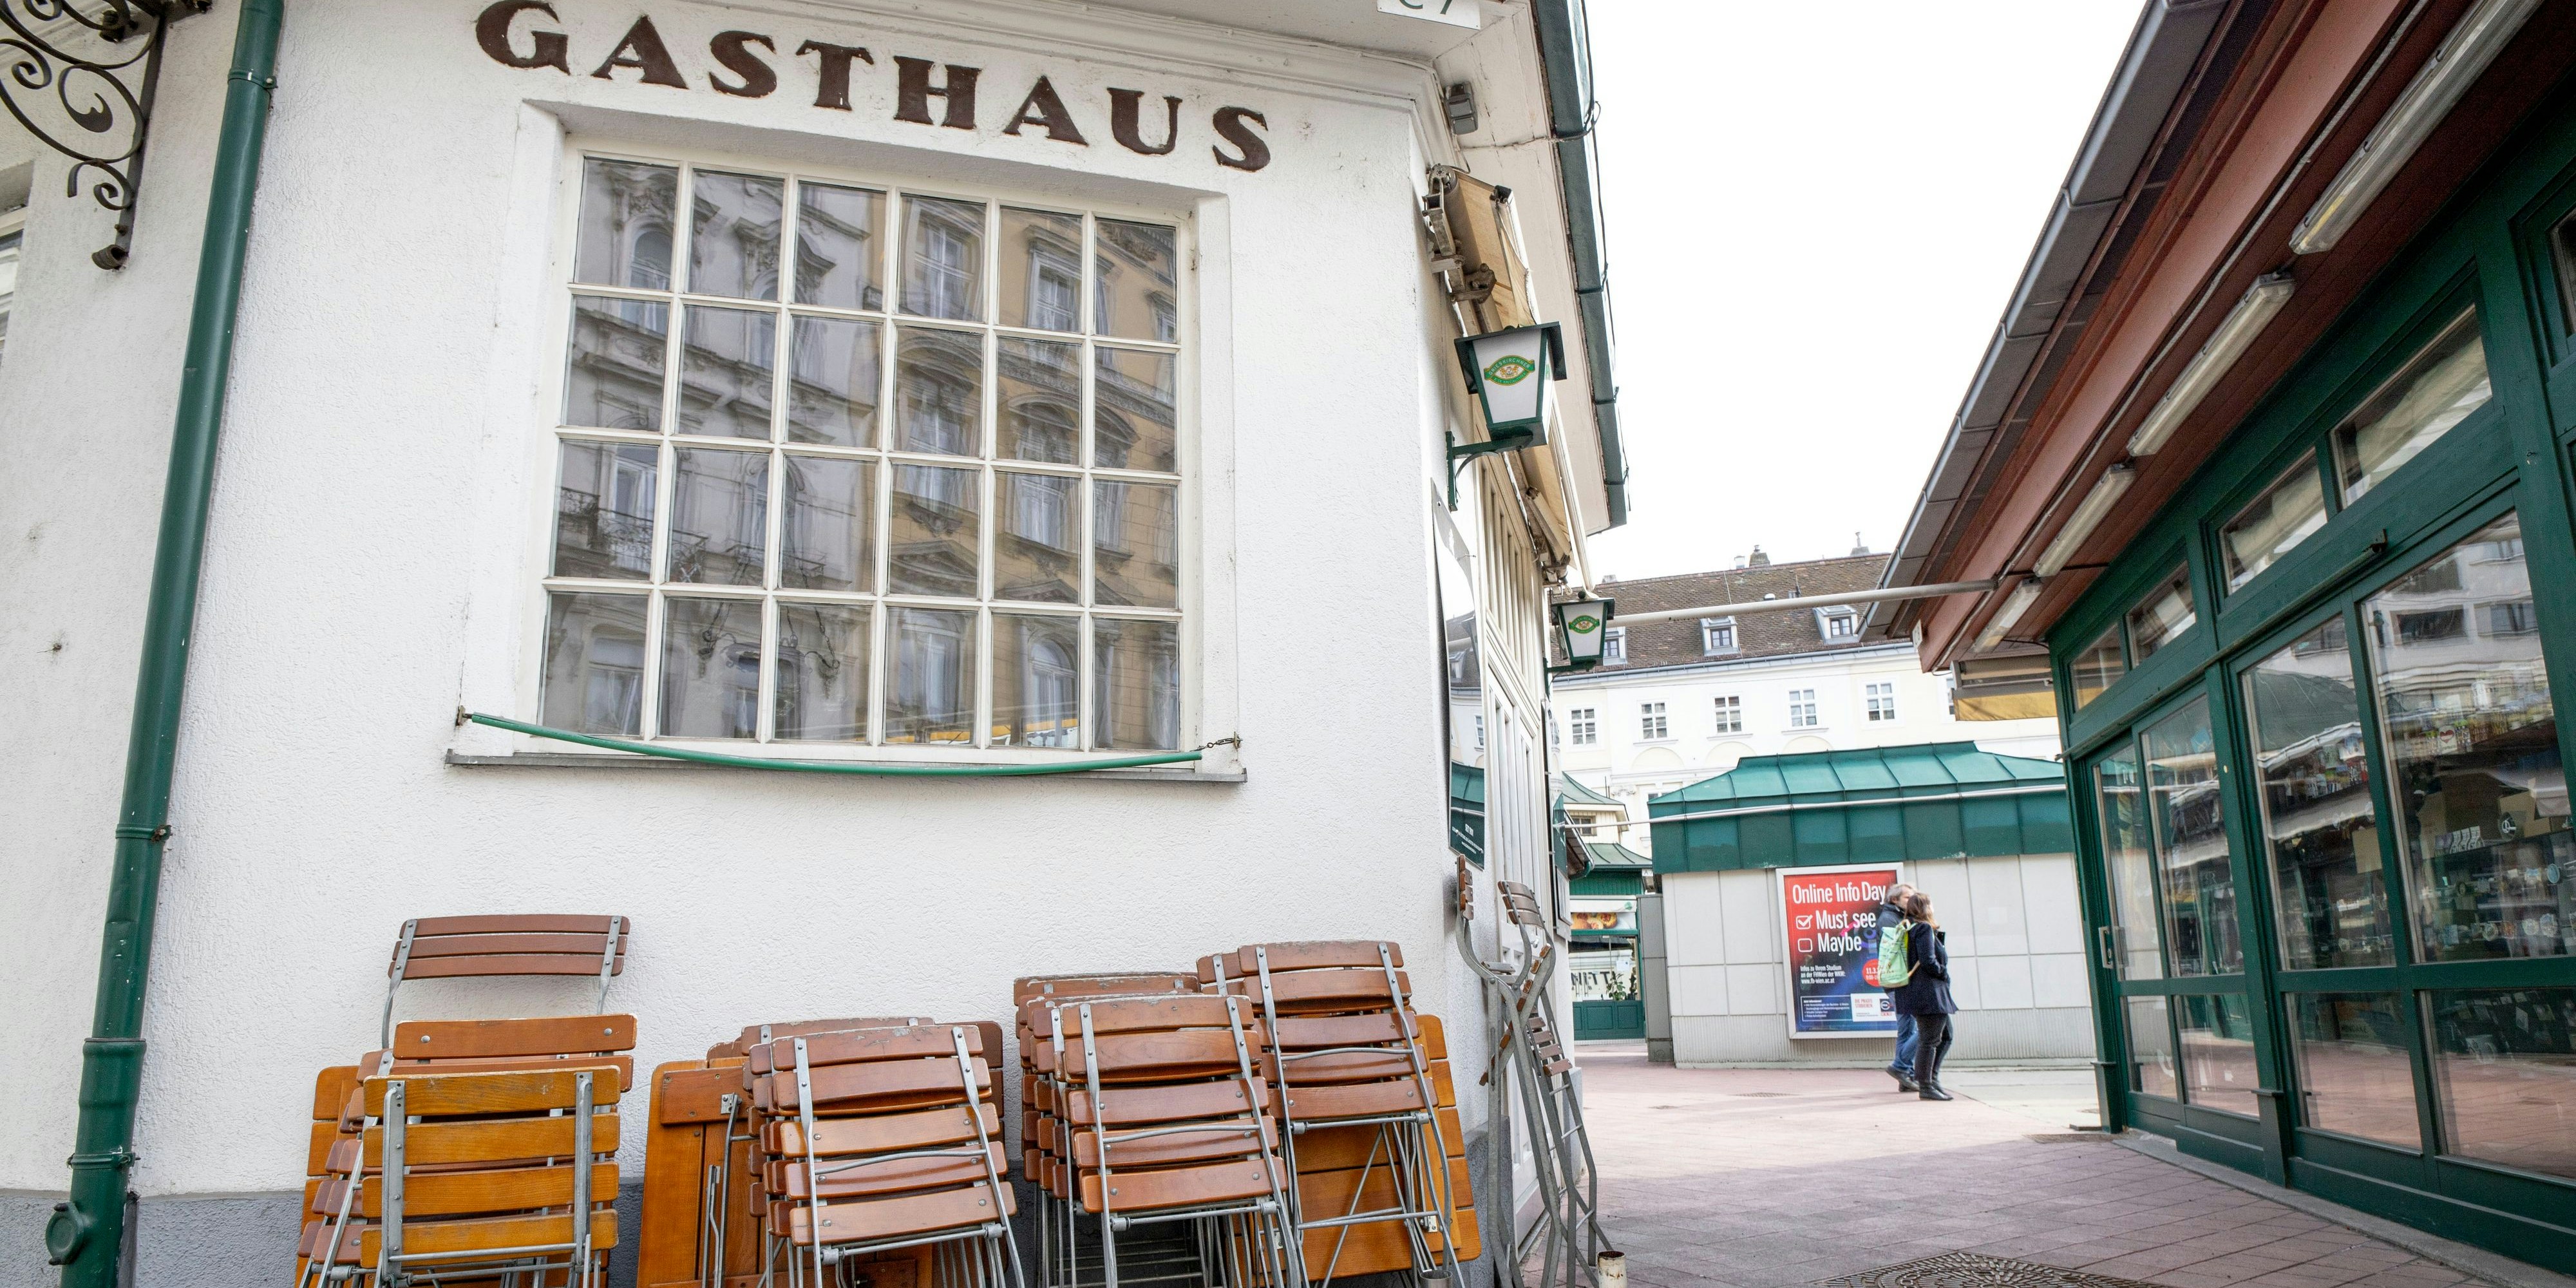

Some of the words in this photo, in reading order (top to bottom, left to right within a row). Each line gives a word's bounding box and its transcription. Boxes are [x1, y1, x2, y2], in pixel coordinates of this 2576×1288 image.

[475, 0, 1271, 172] GASTHAUS
[1792, 884, 1833, 904] Online
[1835, 882, 1860, 902] Info
[1861, 881, 1886, 905] Day
[1815, 910, 1849, 930] Must
[1852, 912, 1876, 928] see
[1817, 932, 1862, 956] Maybe
